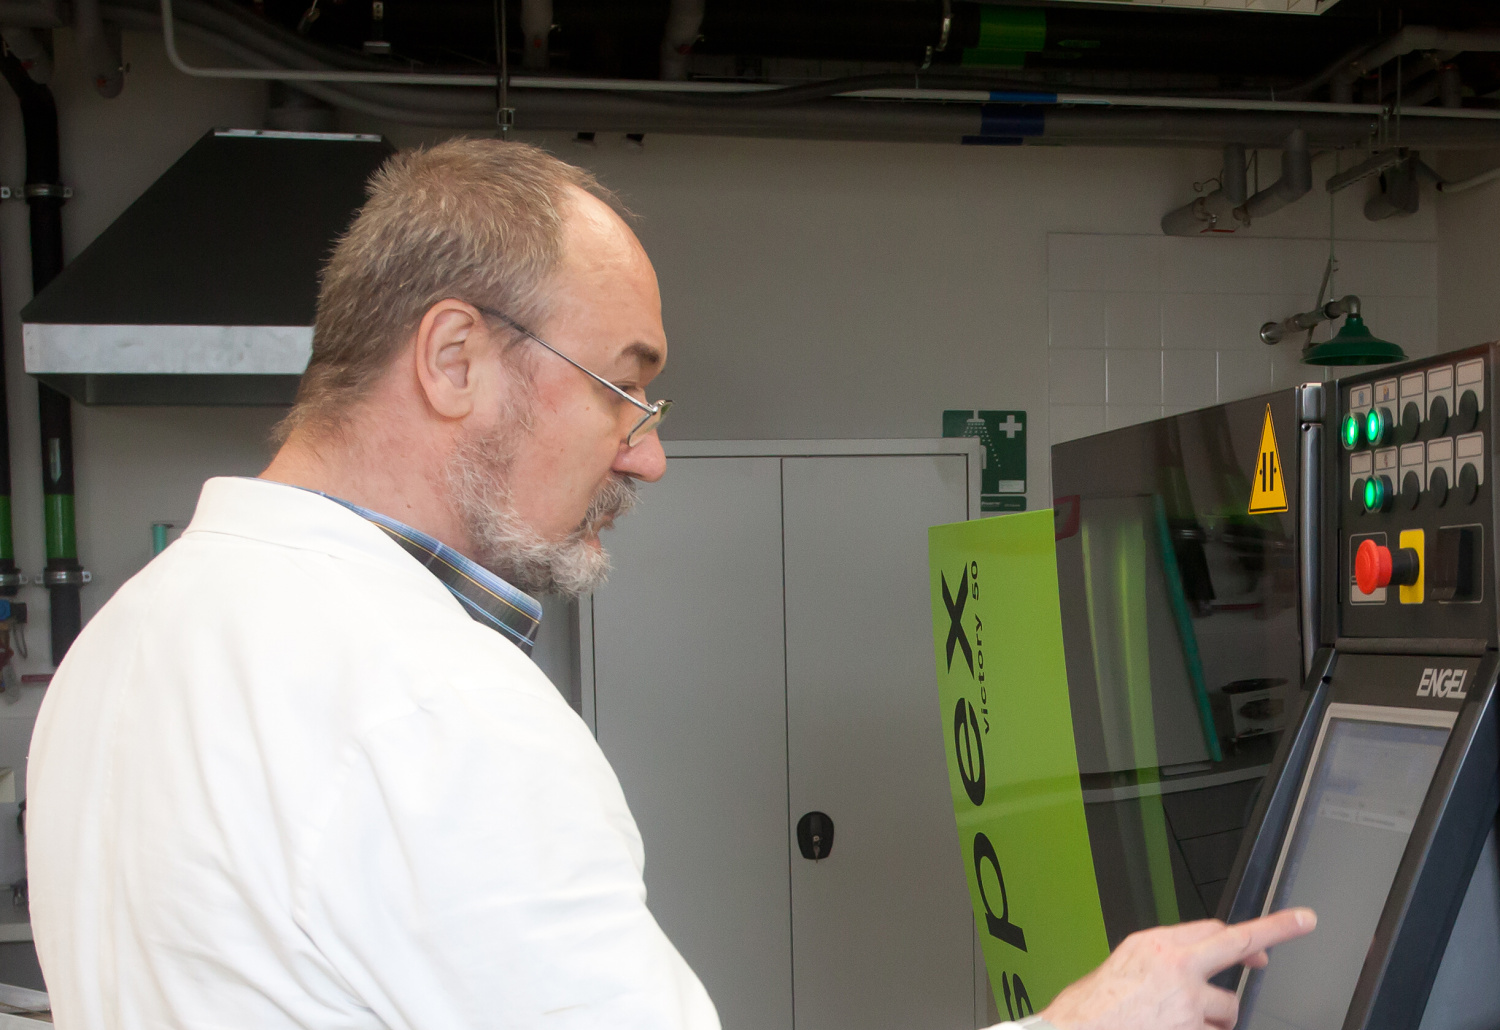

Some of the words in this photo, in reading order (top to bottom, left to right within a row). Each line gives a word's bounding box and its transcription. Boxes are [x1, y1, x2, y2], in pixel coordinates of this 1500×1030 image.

[970, 560, 980, 601] 50
[974, 613, 990, 735] victory
[1416, 667, 1468, 699] ENGEL
